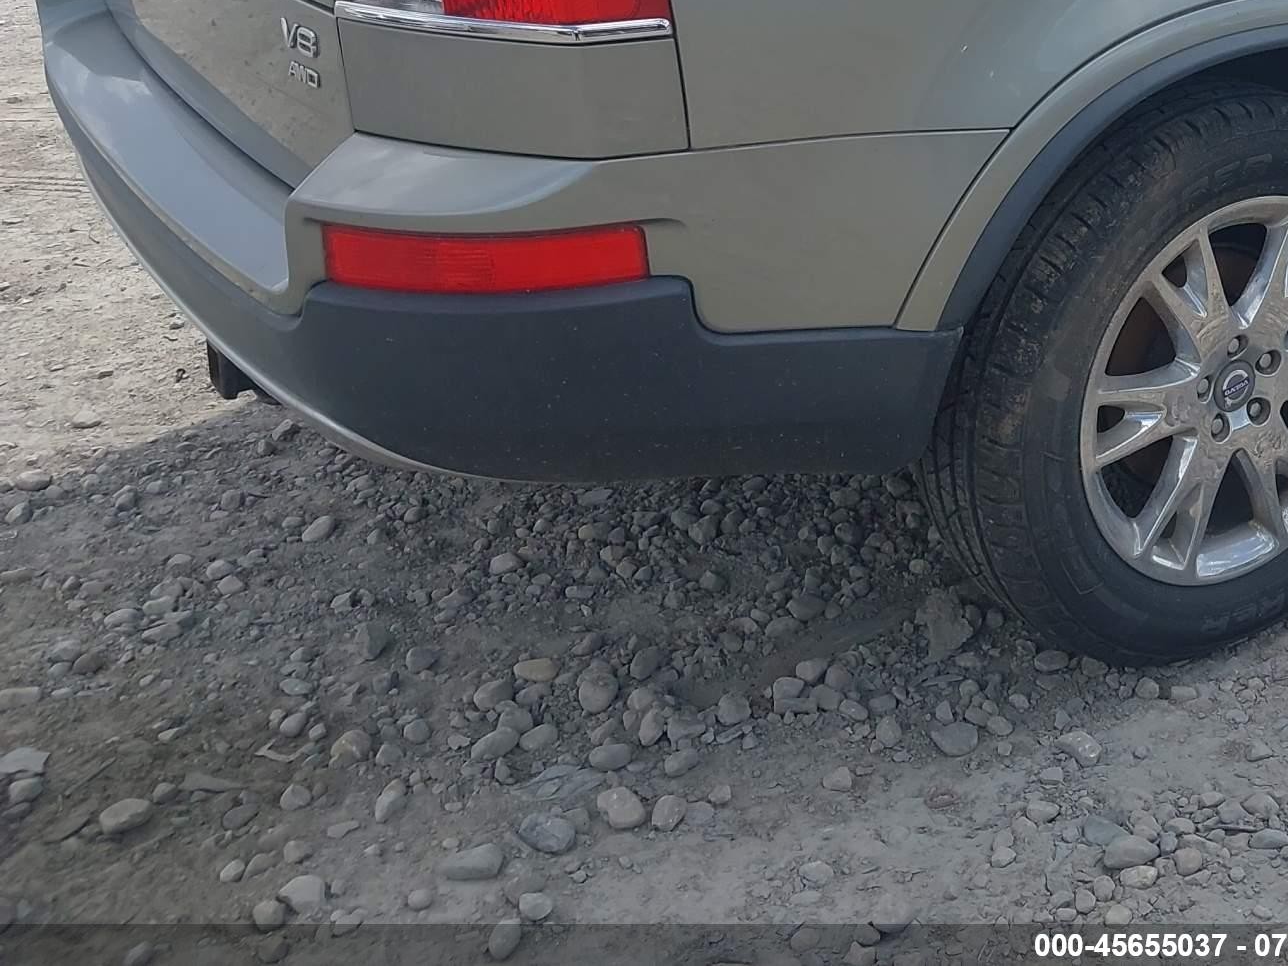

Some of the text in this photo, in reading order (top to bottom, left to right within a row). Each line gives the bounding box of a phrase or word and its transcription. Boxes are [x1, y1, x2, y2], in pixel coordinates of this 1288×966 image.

[280, 17, 318, 58] V8
[288, 60, 320, 88] AWD
[1224, 379, 1249, 396] VOLVO
